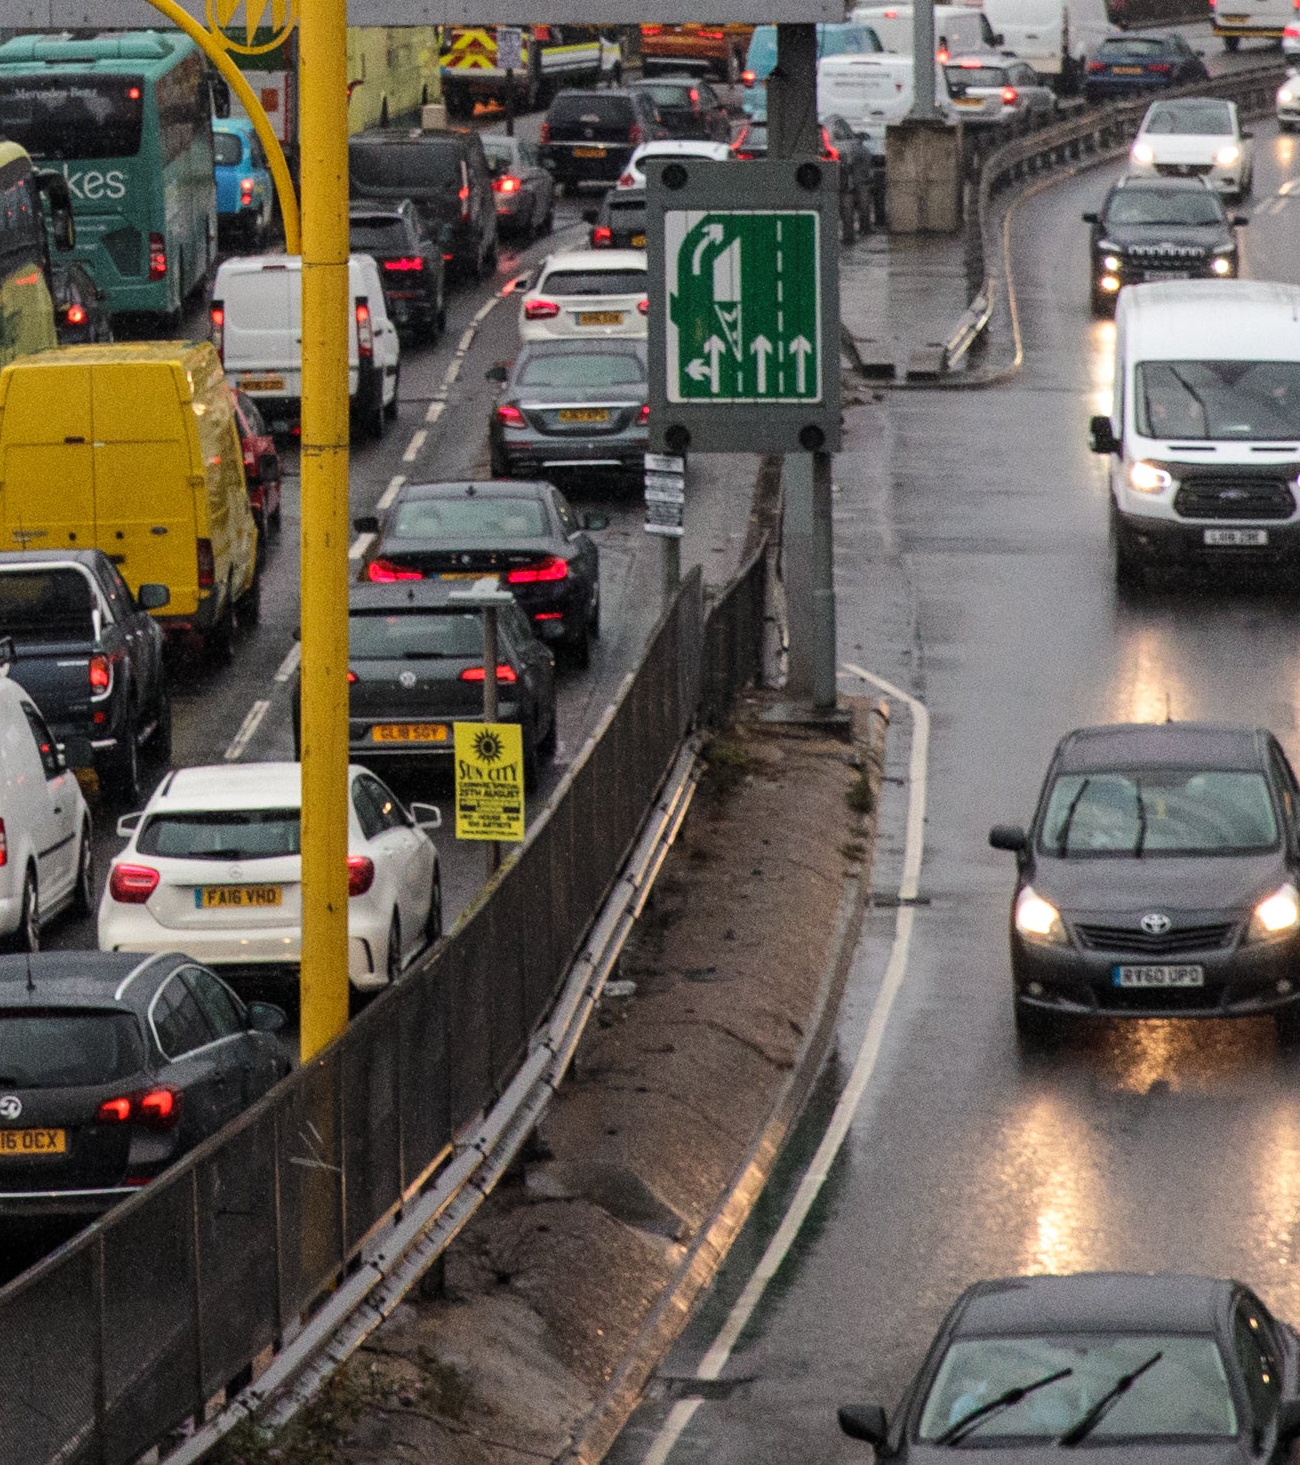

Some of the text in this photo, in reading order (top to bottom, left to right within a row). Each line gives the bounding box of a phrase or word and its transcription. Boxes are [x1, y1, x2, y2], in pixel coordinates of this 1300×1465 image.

[459, 760, 518, 781] SUN CITY
[207, 889, 242, 905] FA16
